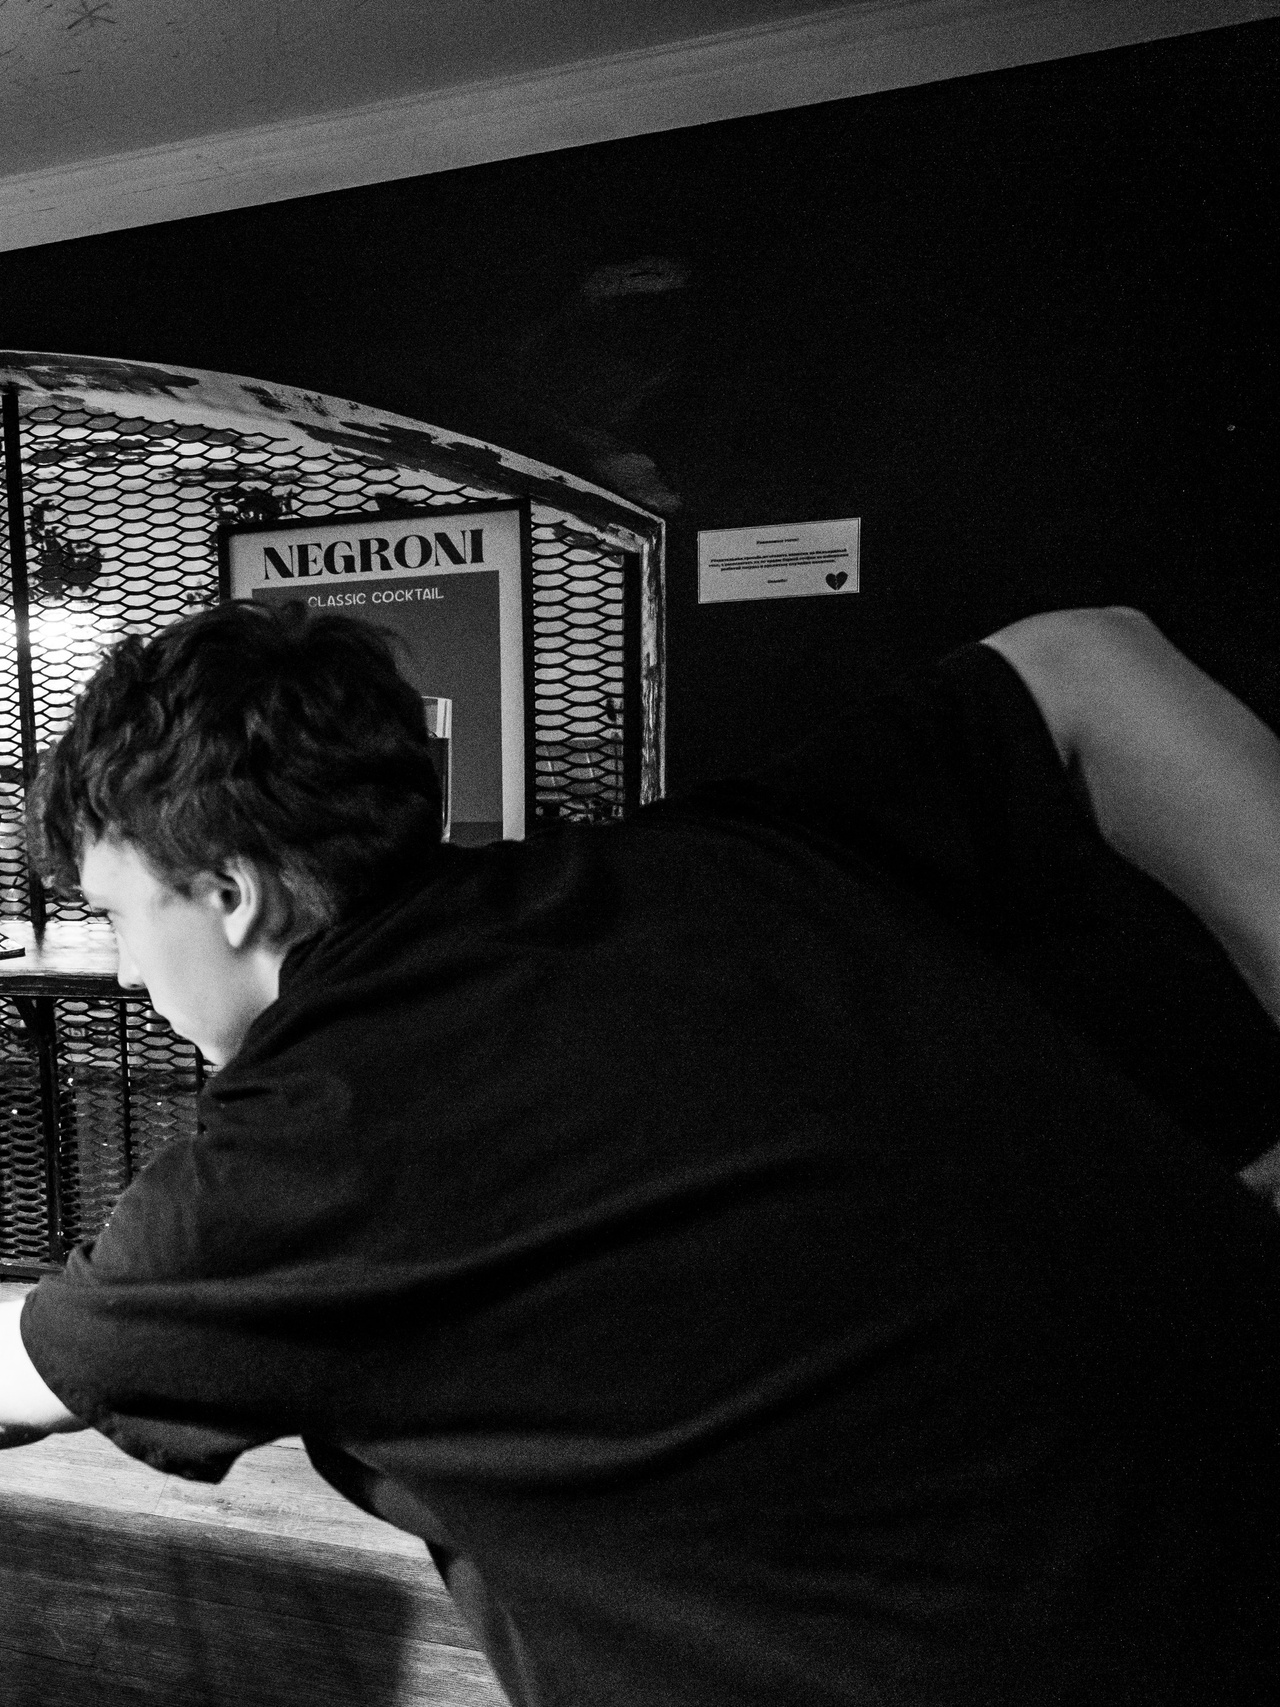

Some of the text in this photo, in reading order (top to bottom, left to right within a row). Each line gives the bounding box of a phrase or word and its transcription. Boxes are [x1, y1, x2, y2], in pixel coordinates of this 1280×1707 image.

[263, 528, 485, 581] NEGRONI
[307, 586, 445, 608] CLASSIC COCKTAIL
